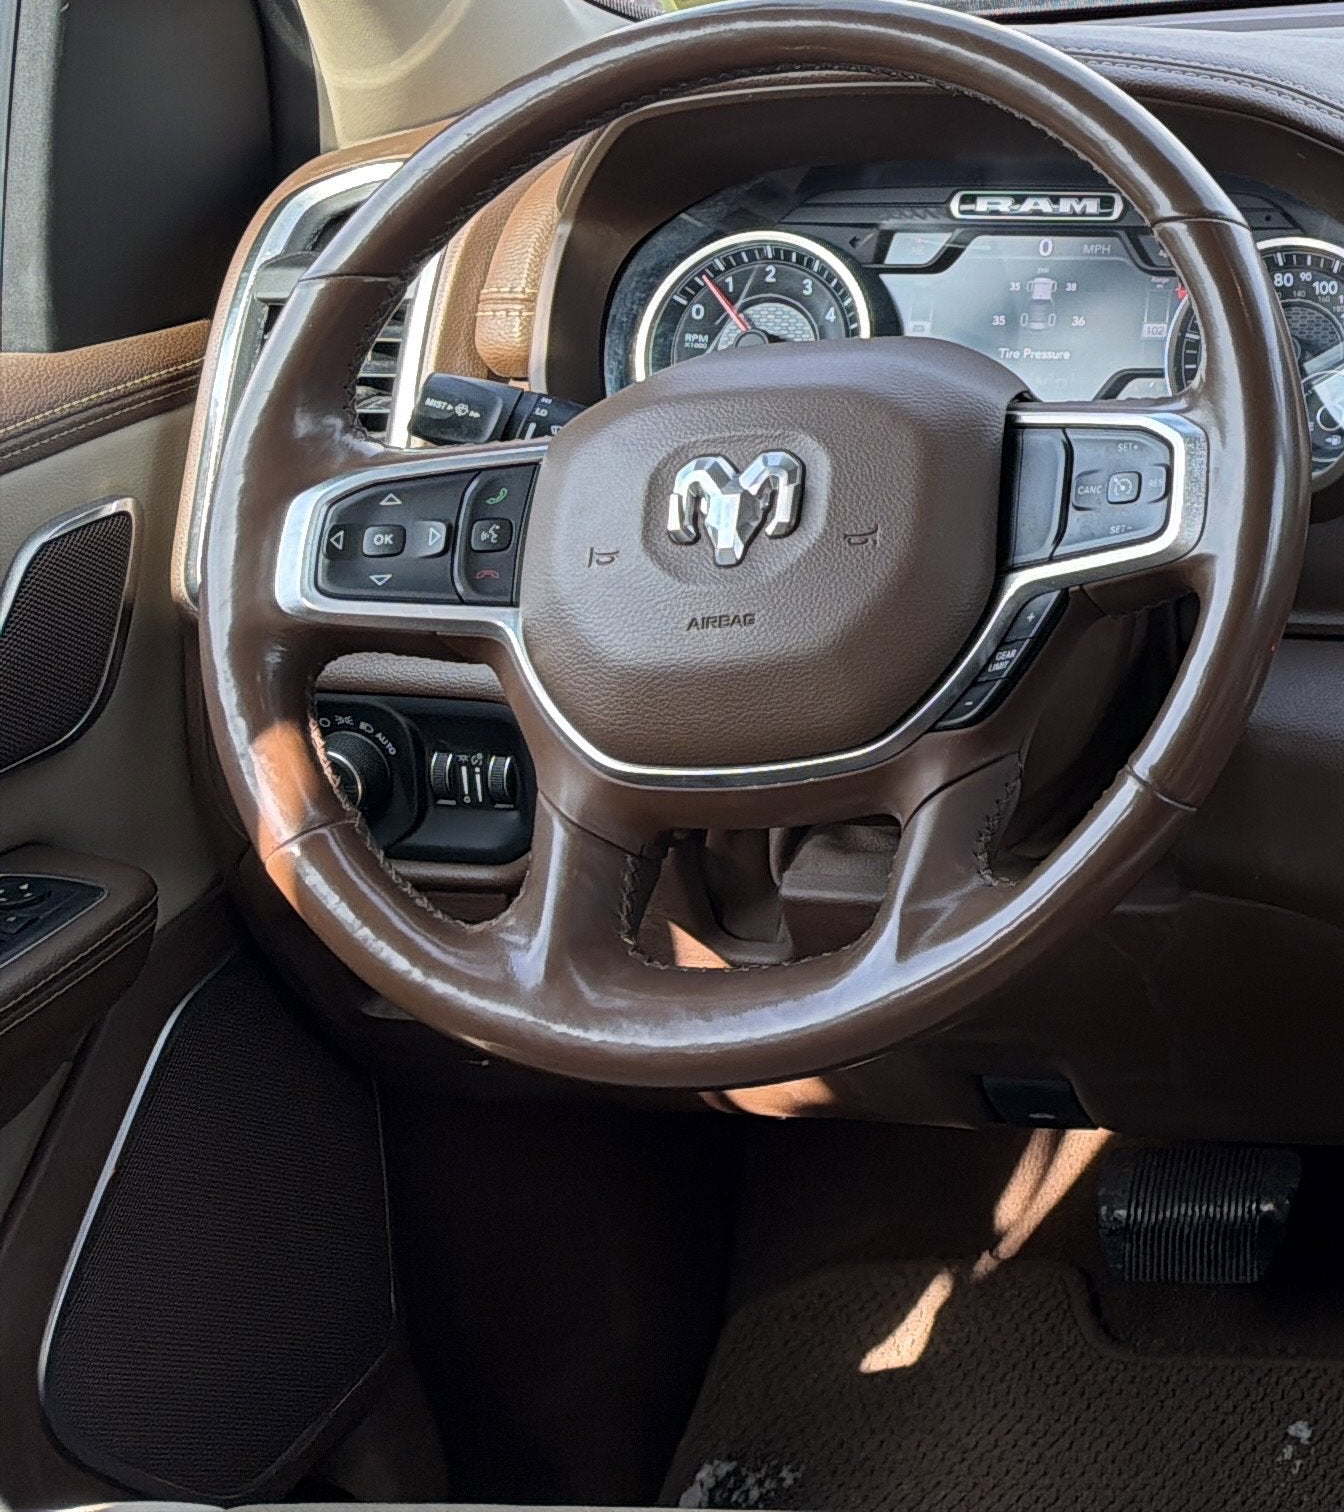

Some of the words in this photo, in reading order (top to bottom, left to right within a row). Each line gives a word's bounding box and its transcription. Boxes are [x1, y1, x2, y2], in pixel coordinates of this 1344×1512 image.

[973, 196, 1100, 214] RAM
[1039, 239, 1053, 257] 0
[1083, 244, 1111, 254] MPH
[765, 265, 777, 283] 2
[1274, 272, 1294, 287] 80
[1300, 272, 1312, 282] 90
[724, 277, 734, 293] 1
[802, 278, 813, 296] 3
[1010, 282, 1021, 291] 35
[1312, 281, 1338, 295] 100
[691, 304, 705, 320] 0
[825, 307, 836, 322] 4
[992, 316, 1006, 326] 35
[1072, 316, 1085, 327] 36
[1145, 326, 1164, 335] 102
[998, 348, 1020, 359] Tire
[1023, 348, 1071, 360] Pressure
[425, 397, 447, 410] MIST
[373, 532, 393, 545] OK
[686, 613, 756, 631] AIRBAG
[373, 731, 397, 756] AUTO
